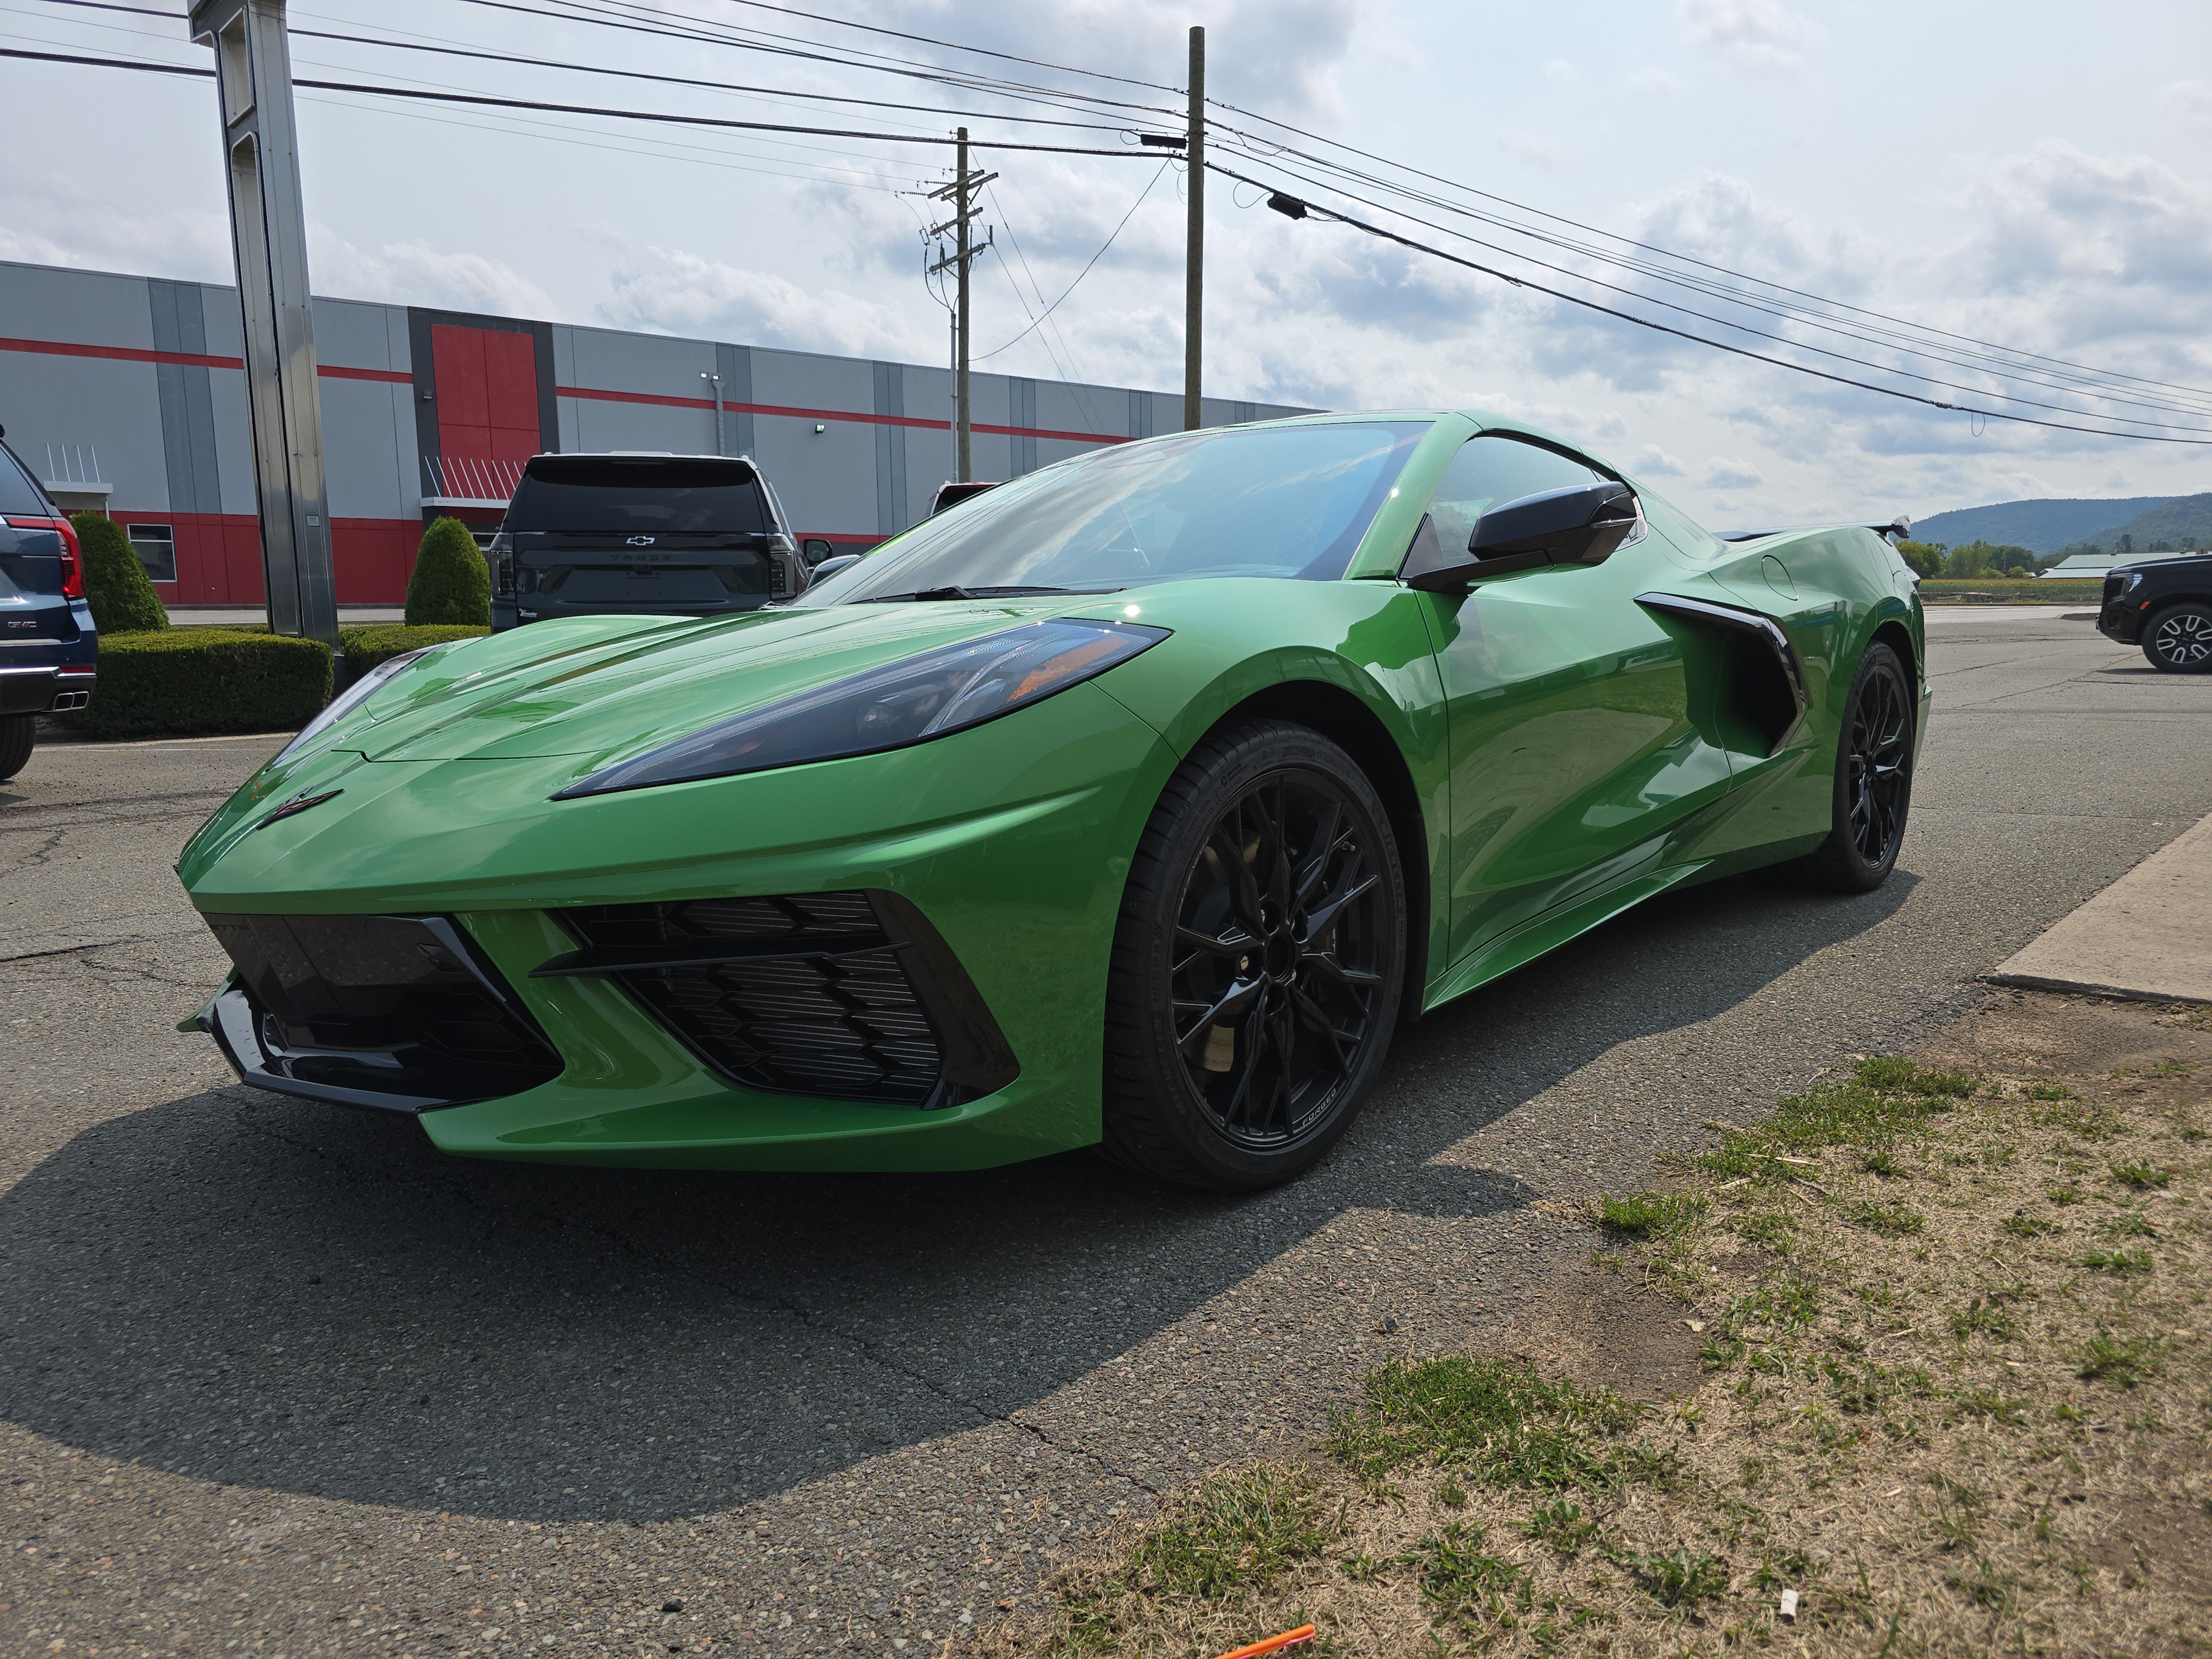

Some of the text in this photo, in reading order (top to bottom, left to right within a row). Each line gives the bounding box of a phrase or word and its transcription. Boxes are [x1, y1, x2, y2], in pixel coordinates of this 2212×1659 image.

[1381, 823, 1404, 907] MICHELIN
[1153, 1017, 1187, 1116] MICHELIN
[1302, 1088, 1336, 1126] FORGED
